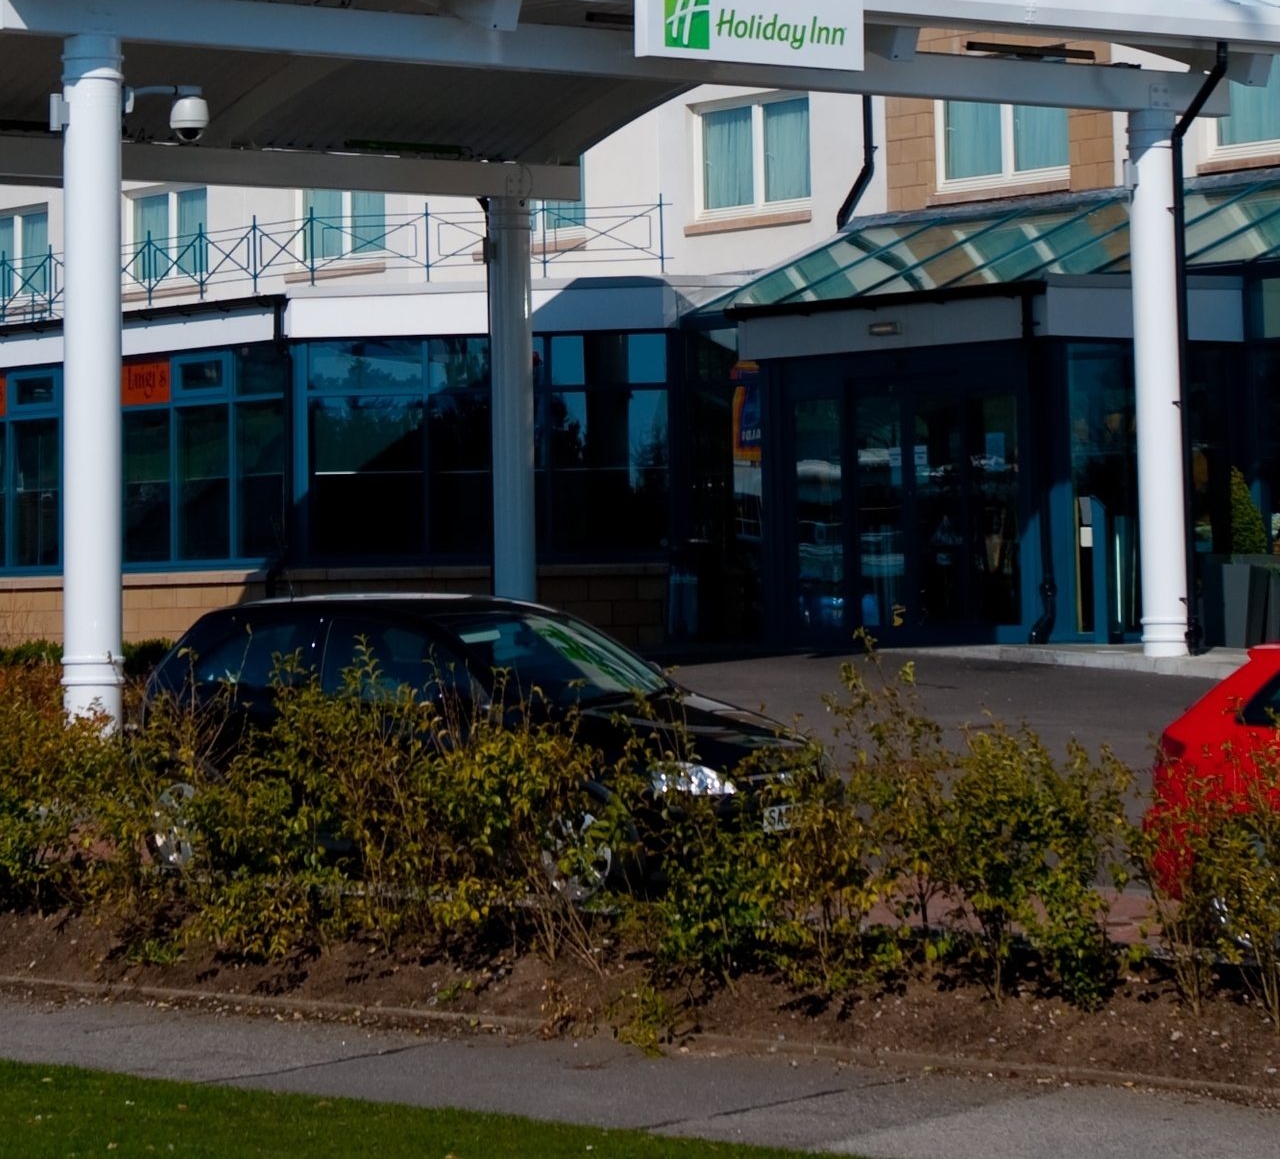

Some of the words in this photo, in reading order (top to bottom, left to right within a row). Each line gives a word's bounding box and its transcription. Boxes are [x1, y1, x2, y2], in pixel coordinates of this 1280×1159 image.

[716, 8, 807, 50] Holiday
[809, 15, 846, 47] Inn
[127, 364, 167, 399] Luigi's
